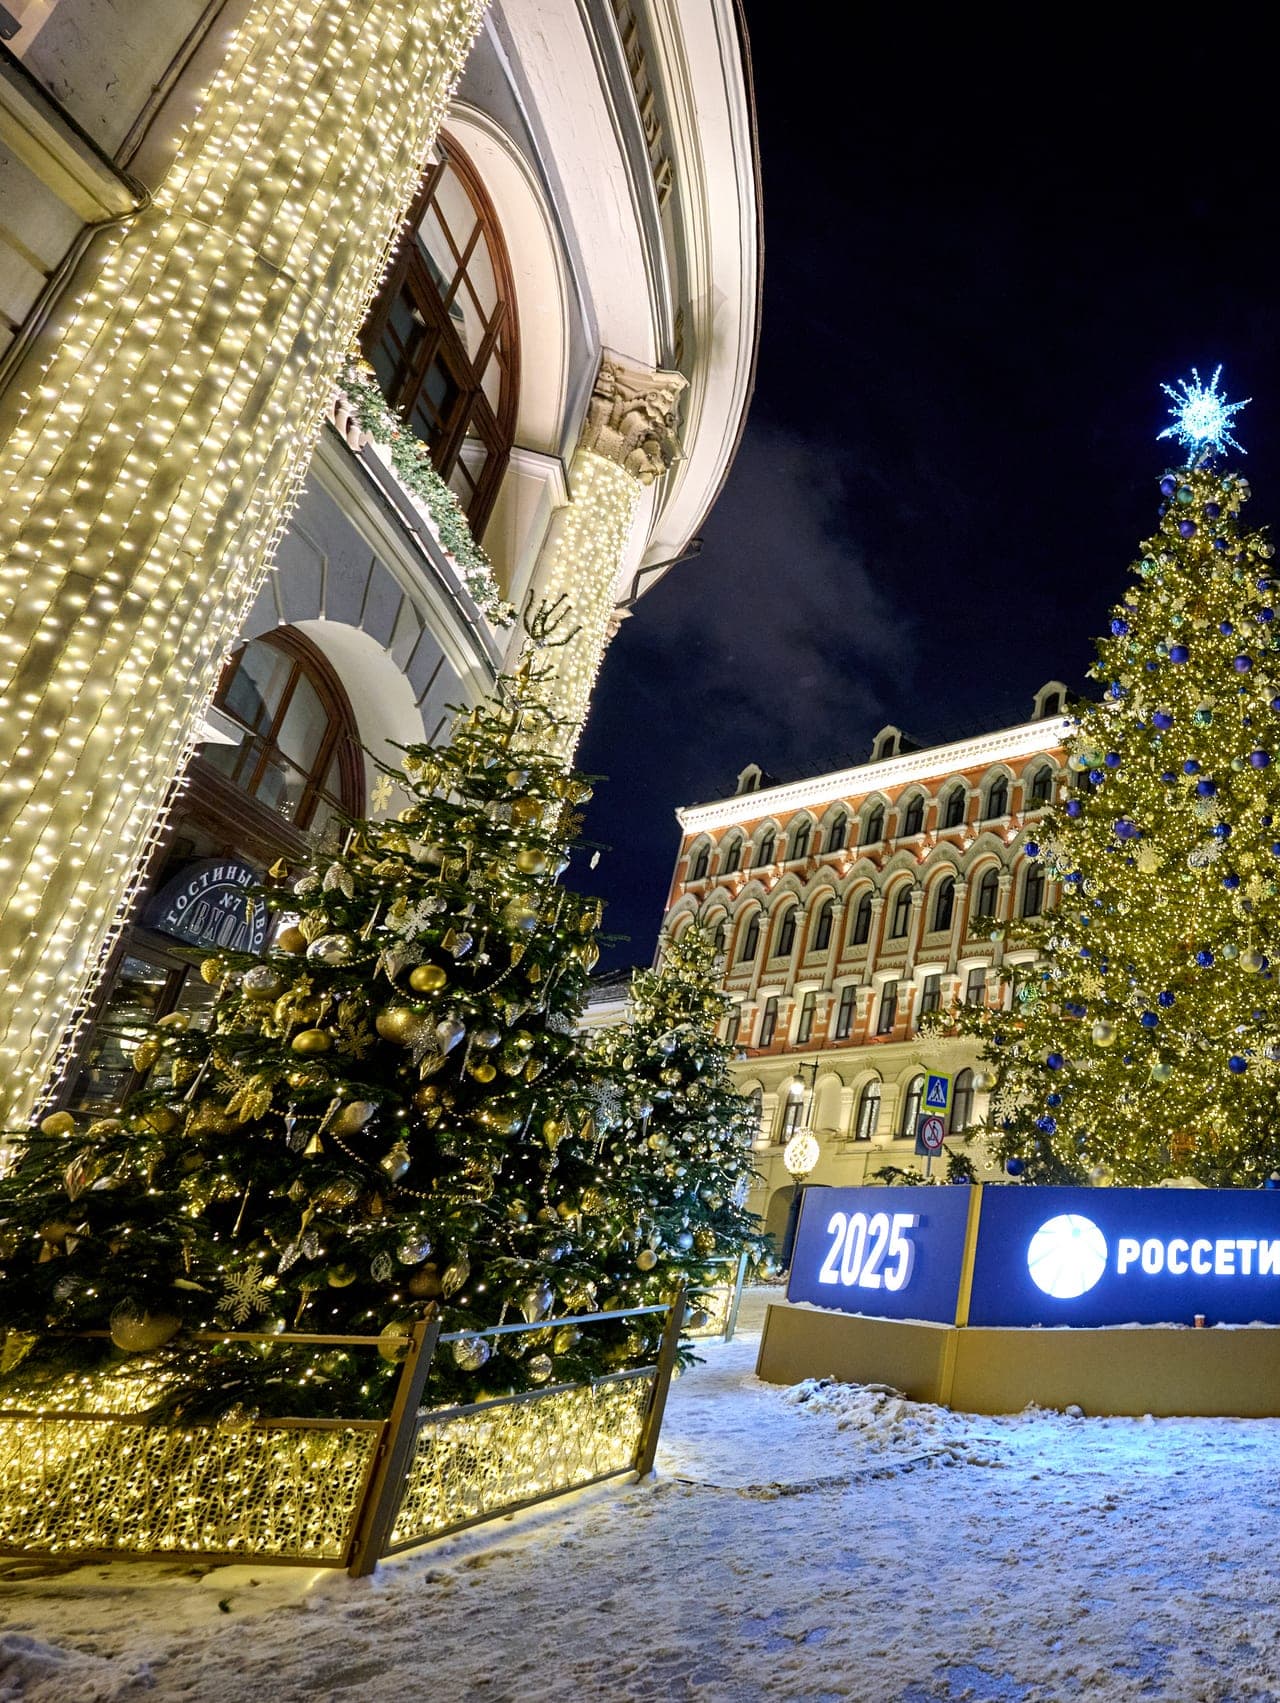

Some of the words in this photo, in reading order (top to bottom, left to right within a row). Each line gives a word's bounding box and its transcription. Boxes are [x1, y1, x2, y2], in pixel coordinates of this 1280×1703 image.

[166, 865, 261, 926] ГОСТИНЫ
[253, 899, 266, 955] ДВО
[818, 1212, 918, 1291] 2025
